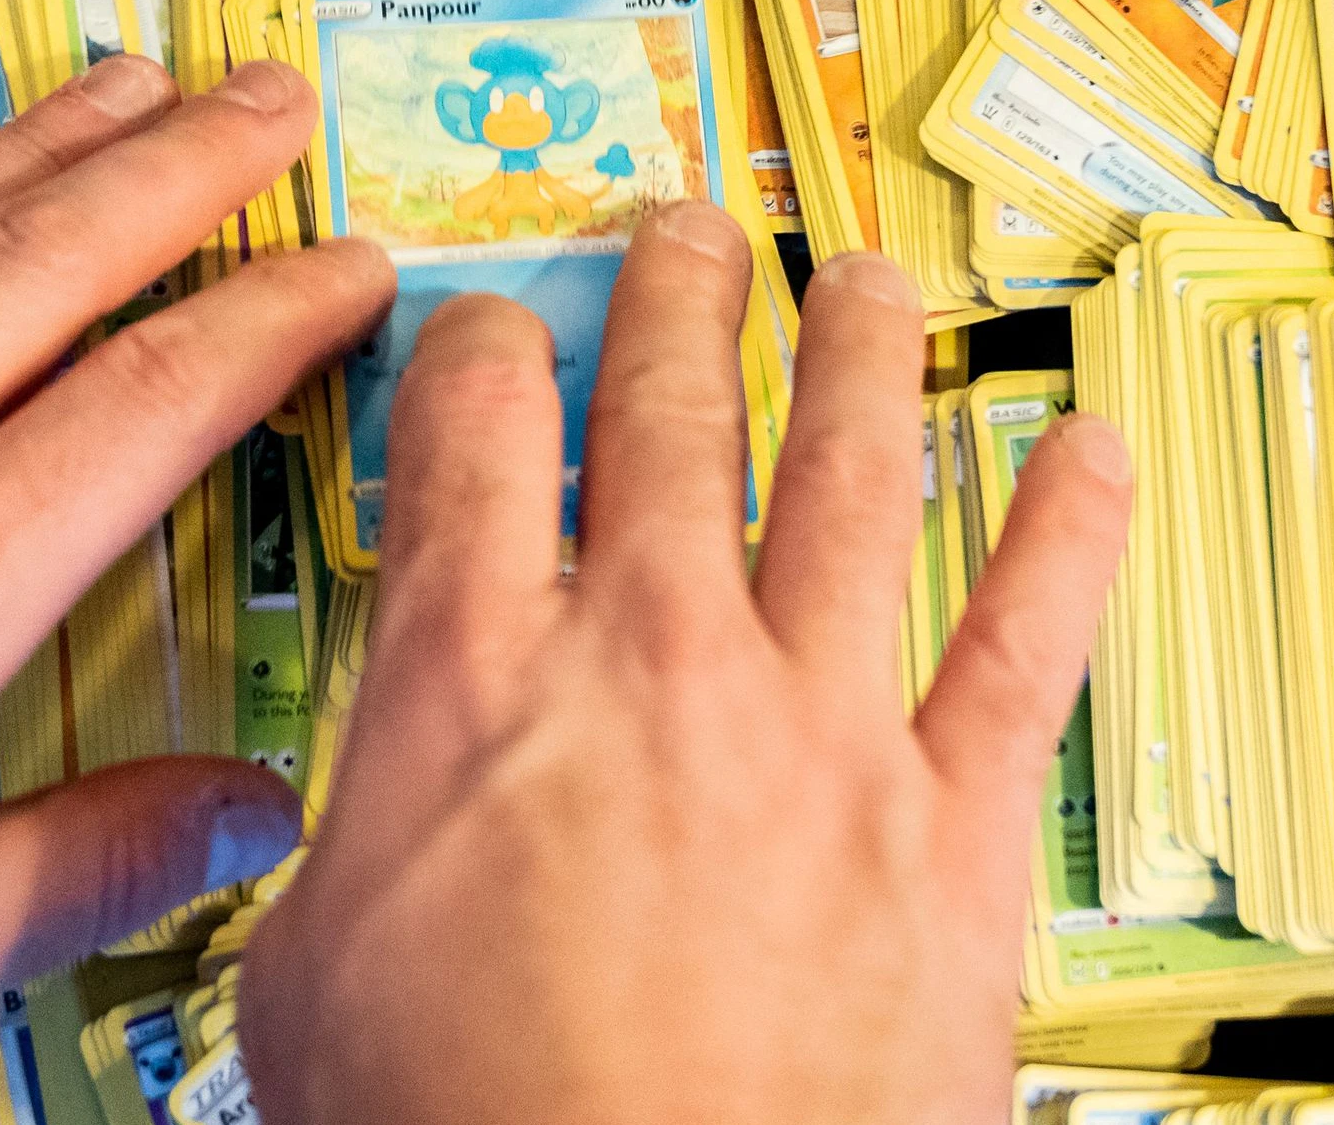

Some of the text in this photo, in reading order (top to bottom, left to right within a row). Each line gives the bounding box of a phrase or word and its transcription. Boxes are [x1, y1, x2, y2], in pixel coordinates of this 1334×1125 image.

[1097, 166, 1131, 193] during
[1124, 167, 1148, 188] may
[989, 404, 1040, 421] BASIC
